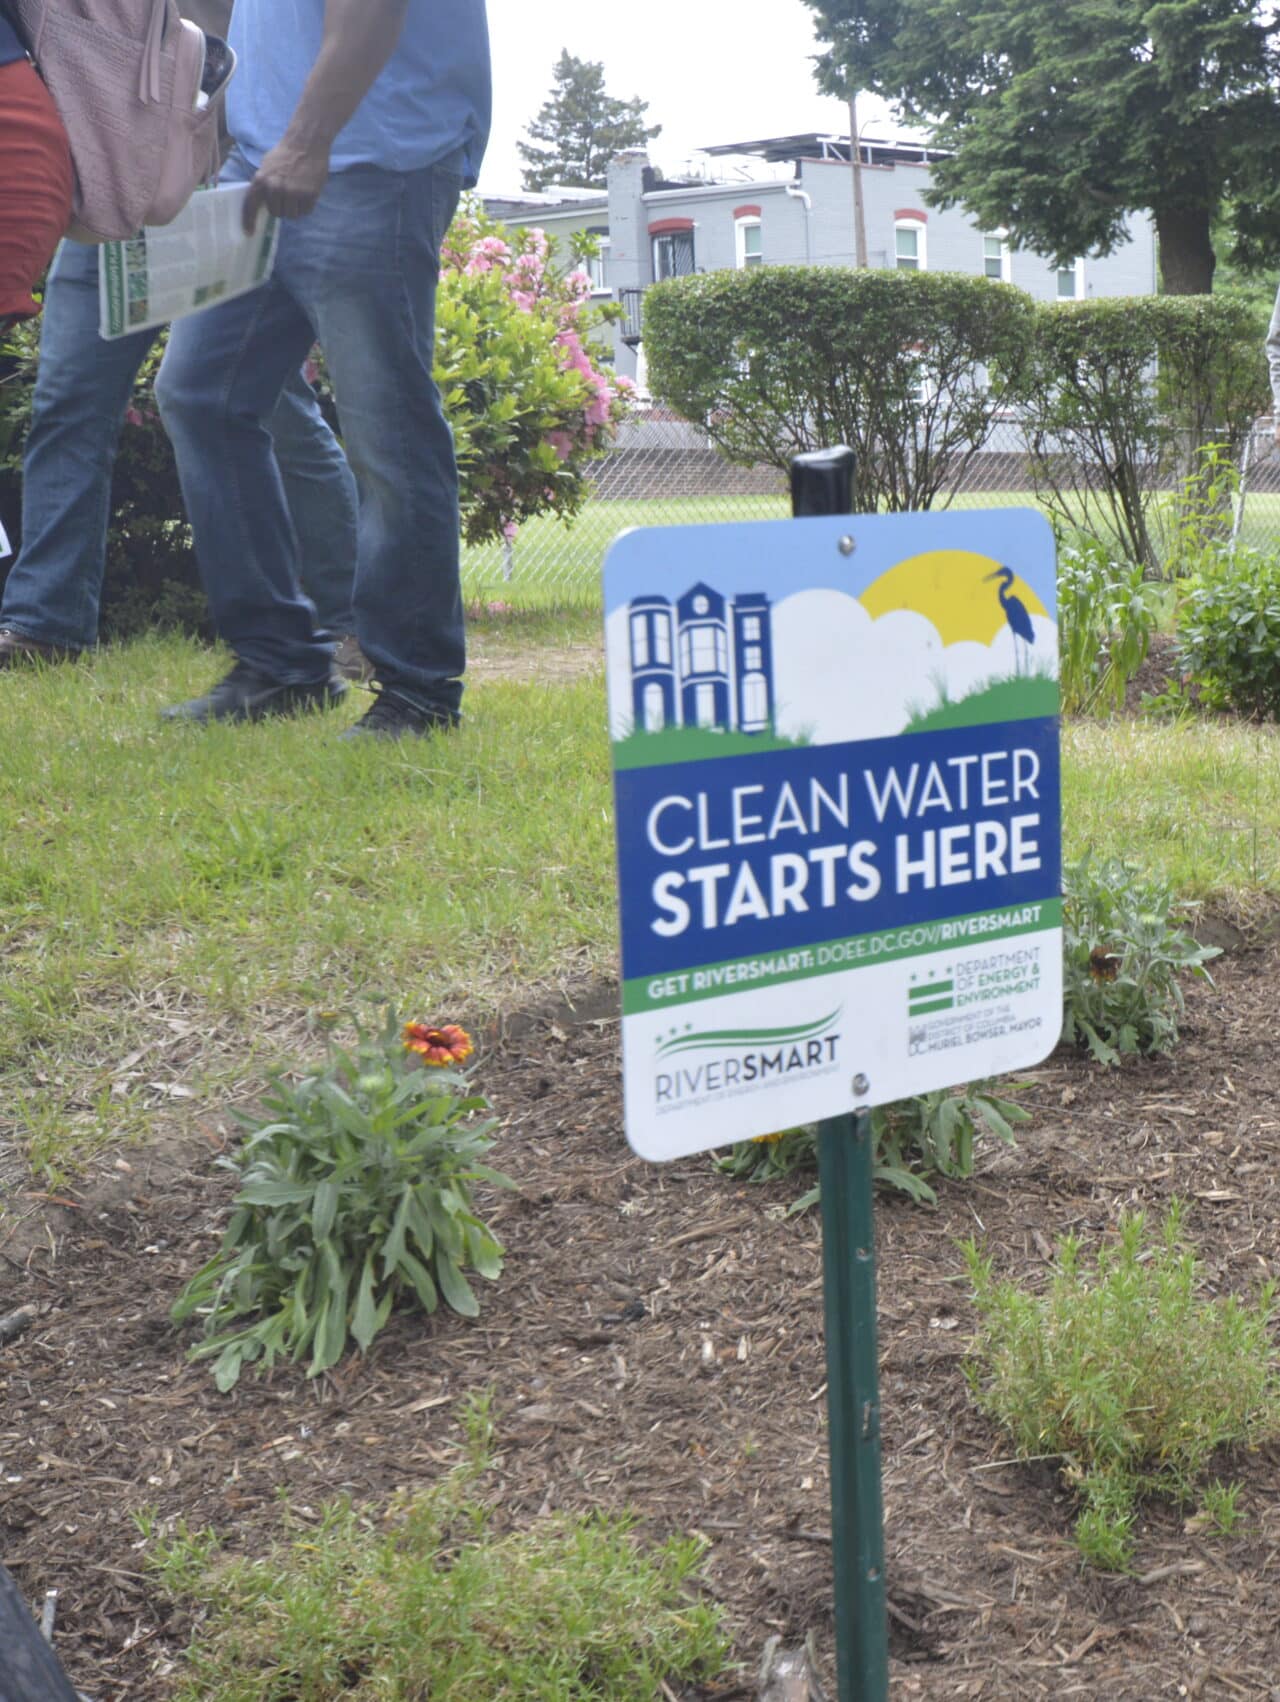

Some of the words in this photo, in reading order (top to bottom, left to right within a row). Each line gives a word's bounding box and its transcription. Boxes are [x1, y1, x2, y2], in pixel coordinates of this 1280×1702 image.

[646, 772, 849, 857] CLEAN
[863, 747, 1041, 824] WATER
[650, 839, 882, 938] STARTS
[895, 812, 1042, 894] HERE
[647, 973, 690, 1000] GET
[692, 949, 814, 991] RIVERSMART:
[817, 905, 1042, 965] DOEE.DC.GOV/RIVERSMART
[956, 946, 1041, 977] DEPARTMENT
[957, 977, 975, 991] OF
[978, 964, 1029, 987] ENERGY
[1031, 962, 1040, 975] &
[956, 977, 1041, 1007] ENVIRONMENT
[1009, 1016, 1042, 1033] MAYOR
[655, 1034, 841, 1104] RIVERSMART
